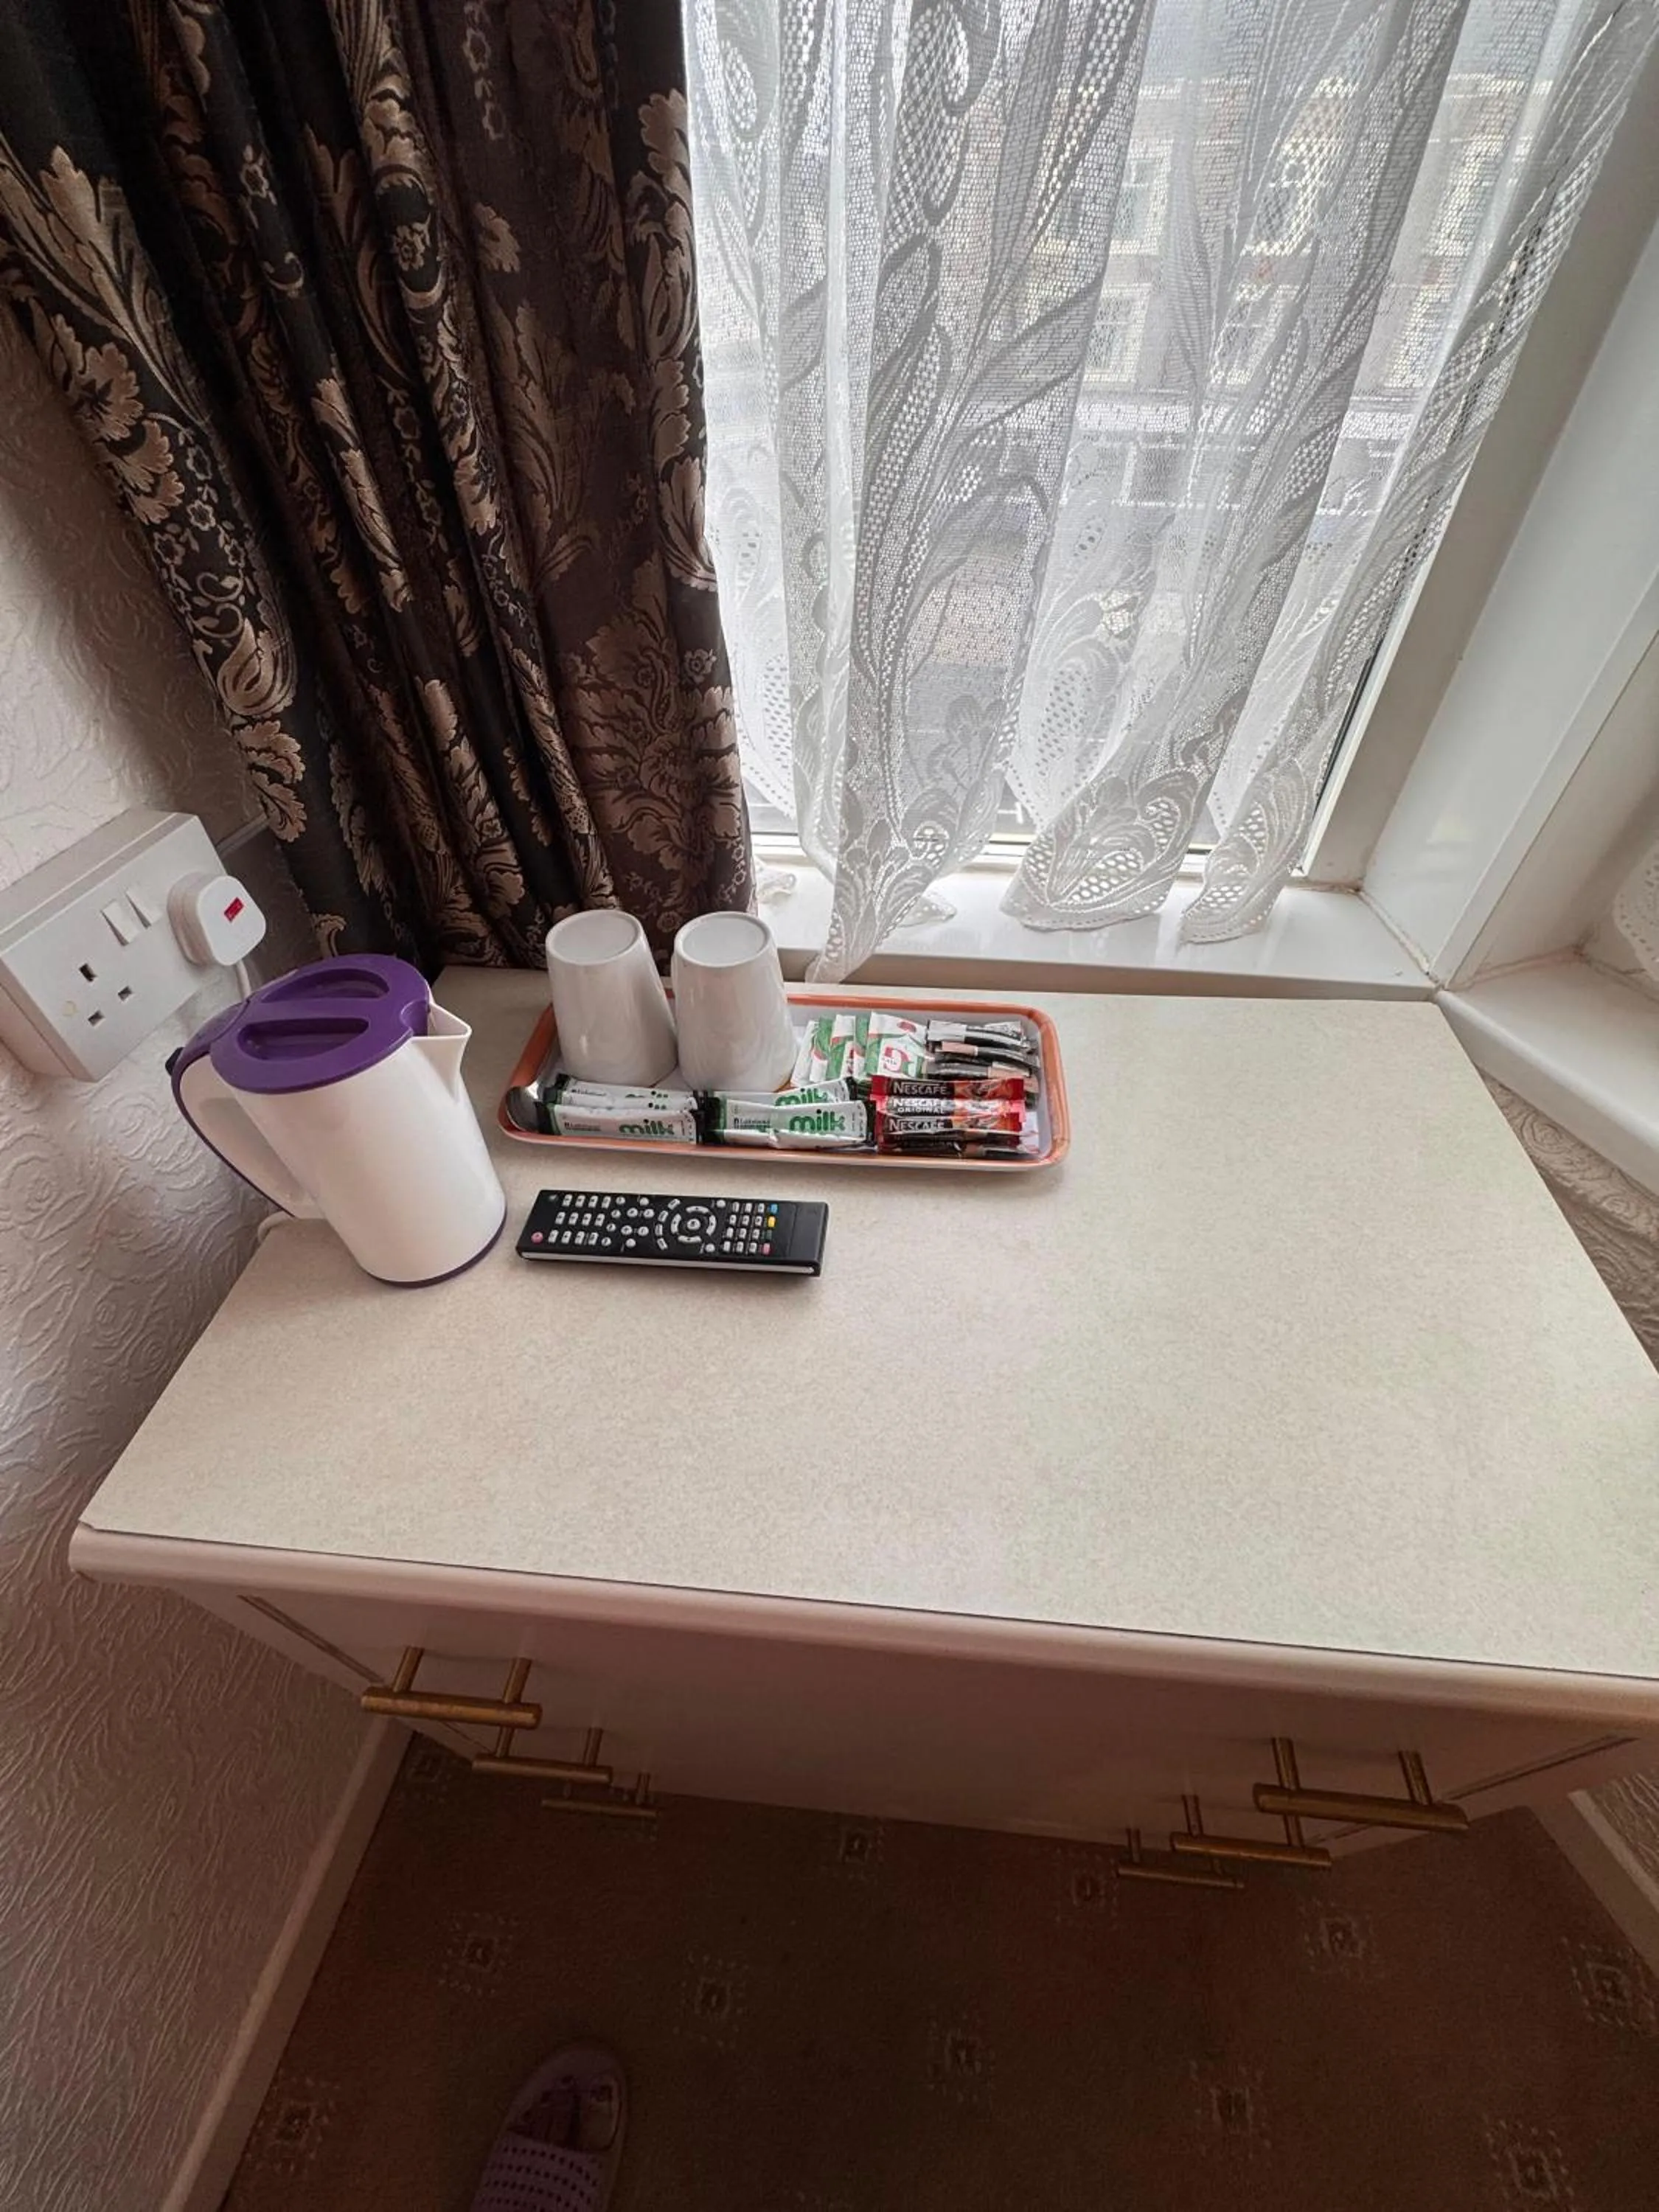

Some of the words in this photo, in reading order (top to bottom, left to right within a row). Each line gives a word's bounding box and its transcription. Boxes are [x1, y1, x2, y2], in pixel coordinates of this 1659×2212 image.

[775, 1088, 828, 1106] milk
[619, 1119, 675, 1135] milk
[789, 1109, 846, 1131] milk
